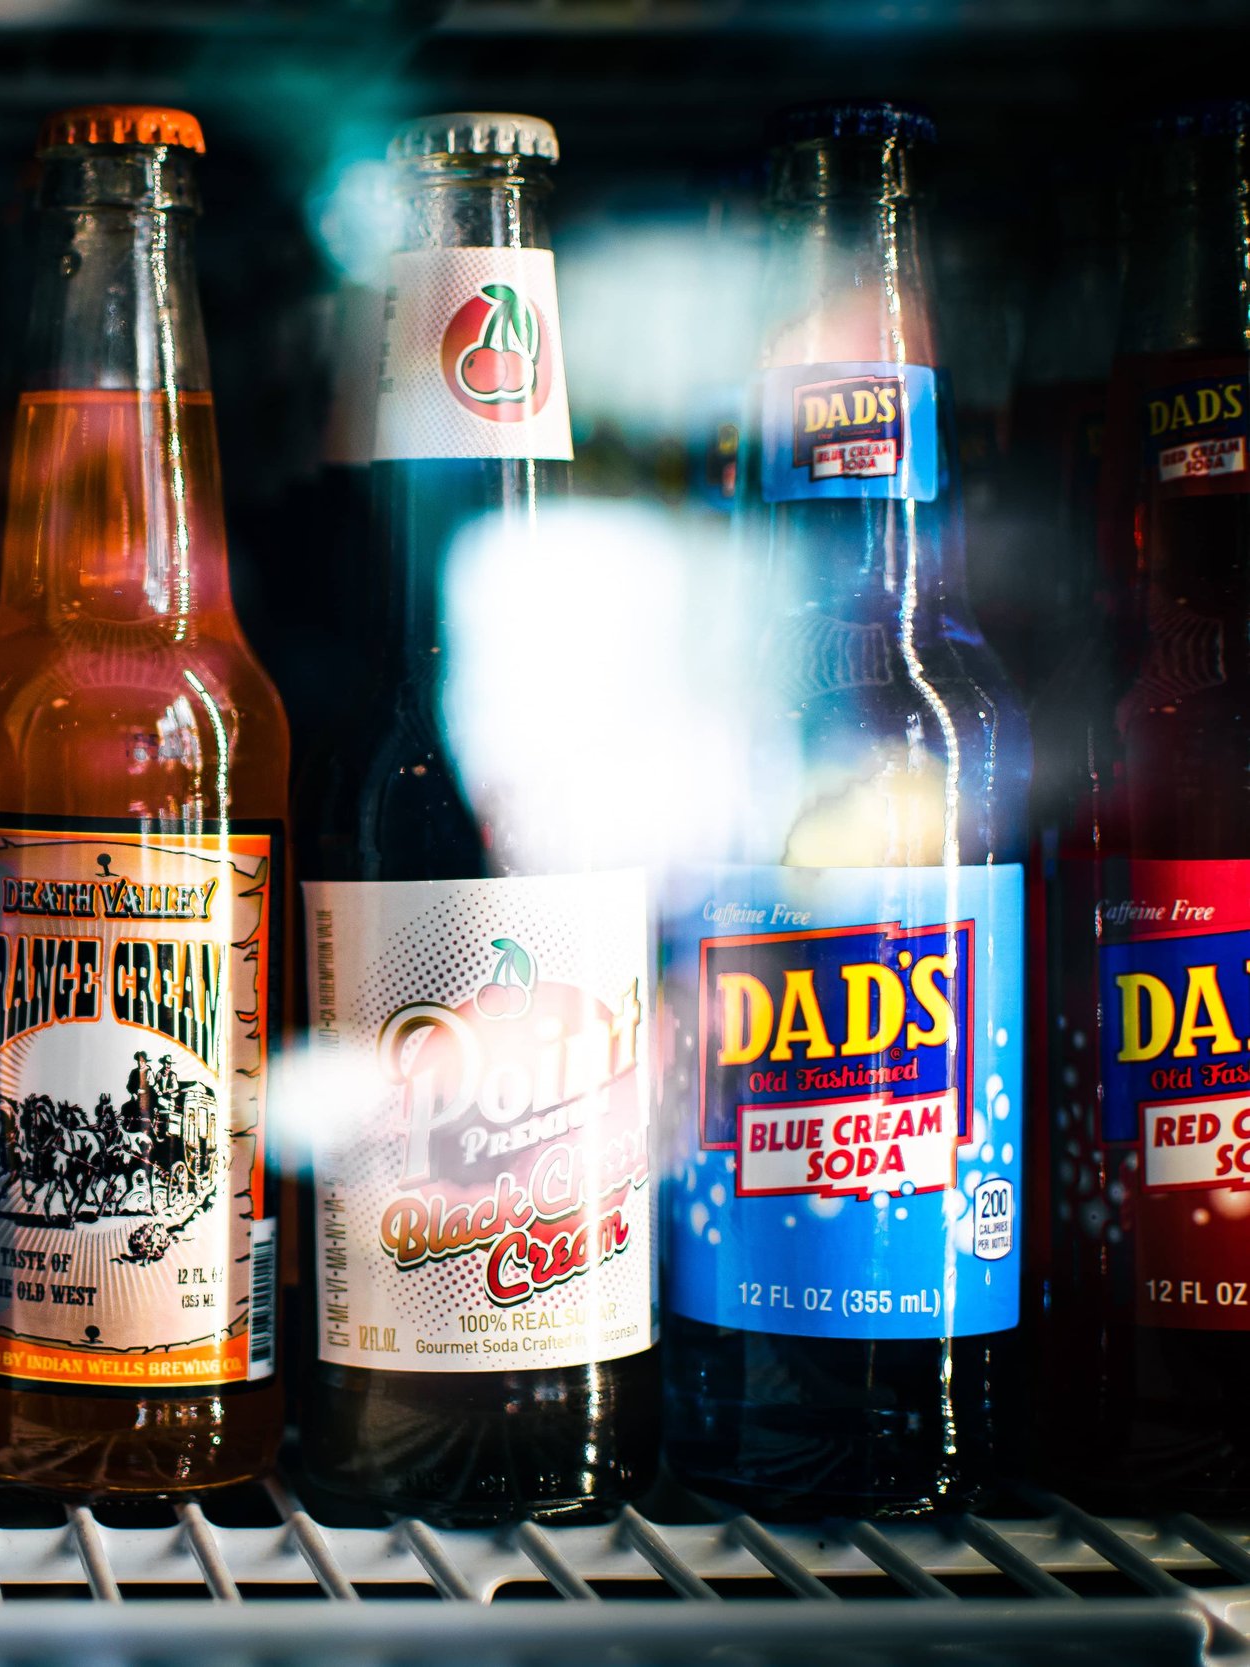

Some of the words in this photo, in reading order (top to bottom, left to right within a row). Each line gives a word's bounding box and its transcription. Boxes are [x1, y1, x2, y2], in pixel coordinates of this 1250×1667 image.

[804, 386, 897, 433] DAD'S
[1149, 383, 1244, 437] DAD'S
[4, 879, 97, 918] DEATH
[100, 878, 217, 919] VALLEY
[702, 899, 766, 928] Caffeine
[769, 902, 812, 926] Free
[1096, 899, 1167, 925] Caffeine
[1170, 898, 1216, 922] Free
[111, 939, 226, 1079] CREAM
[717, 950, 957, 1067] DAD'S
[1115, 958, 1250, 1064] DA
[750, 1071, 789, 1093] Old
[796, 1058, 919, 1091] Fashioned
[1151, 1066, 1194, 1090] Old
[1201, 1061, 1250, 1088] Fas
[749, 1118, 824, 1153] BLUE
[833, 1105, 943, 1146] CREAM
[1155, 1113, 1221, 1148] RED
[806, 1144, 906, 1182] SODA
[981, 1188, 1008, 1219] 200
[379, 1172, 533, 1271] Black
[0, 1247, 46, 1271] TASTE
[52, 1253, 72, 1273] OF
[485, 1210, 631, 1307] Cream
[17, 1281, 45, 1302] OLD
[51, 1284, 97, 1306] WEST
[177, 1268, 189, 1285] 12
[1146, 1279, 1173, 1303] 12
[1180, 1280, 1209, 1305] FL
[1216, 1281, 1248, 1306] OZ
[738, 1281, 762, 1306] 12
[769, 1285, 795, 1309] FL
[804, 1287, 833, 1312] OZ
[842, 1288, 893, 1318] (355
[900, 1288, 941, 1318] mL)
[458, 1313, 508, 1334] 100%
[511, 1310, 562, 1332] REAL
[564, 1302, 617, 1328] SUAR
[358, 1325, 369, 1351] 12
[415, 1339, 479, 1354] Gourmet
[482, 1338, 518, 1353] Soda
[522, 1334, 573, 1352] Crafted
[3, 1351, 25, 1368] BY
[26, 1354, 82, 1374] INDIAN
[86, 1356, 146, 1376] WELLS
[148, 1357, 220, 1377] BREWING
